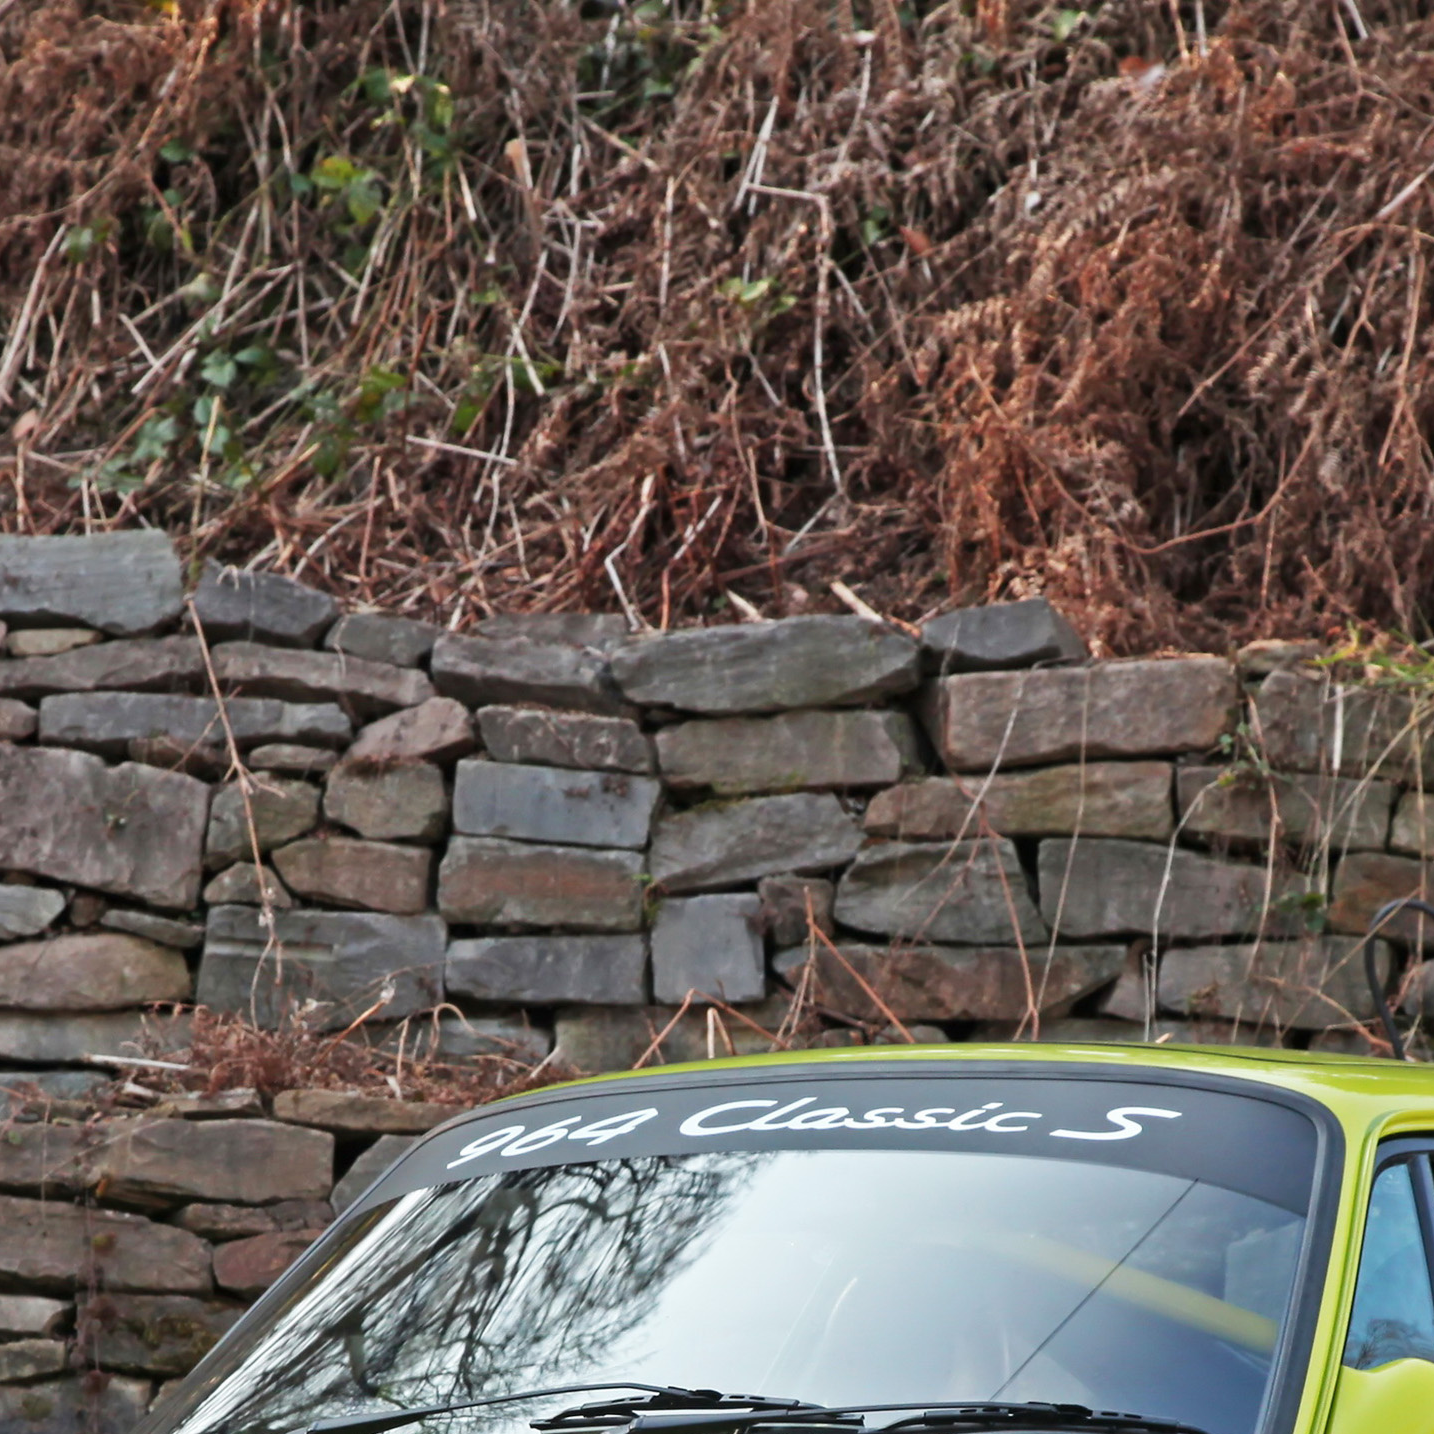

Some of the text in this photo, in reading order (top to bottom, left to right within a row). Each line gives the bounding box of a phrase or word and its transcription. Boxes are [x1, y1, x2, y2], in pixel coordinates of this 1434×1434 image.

[446, 1096, 1183, 1169] 964 Classic S
